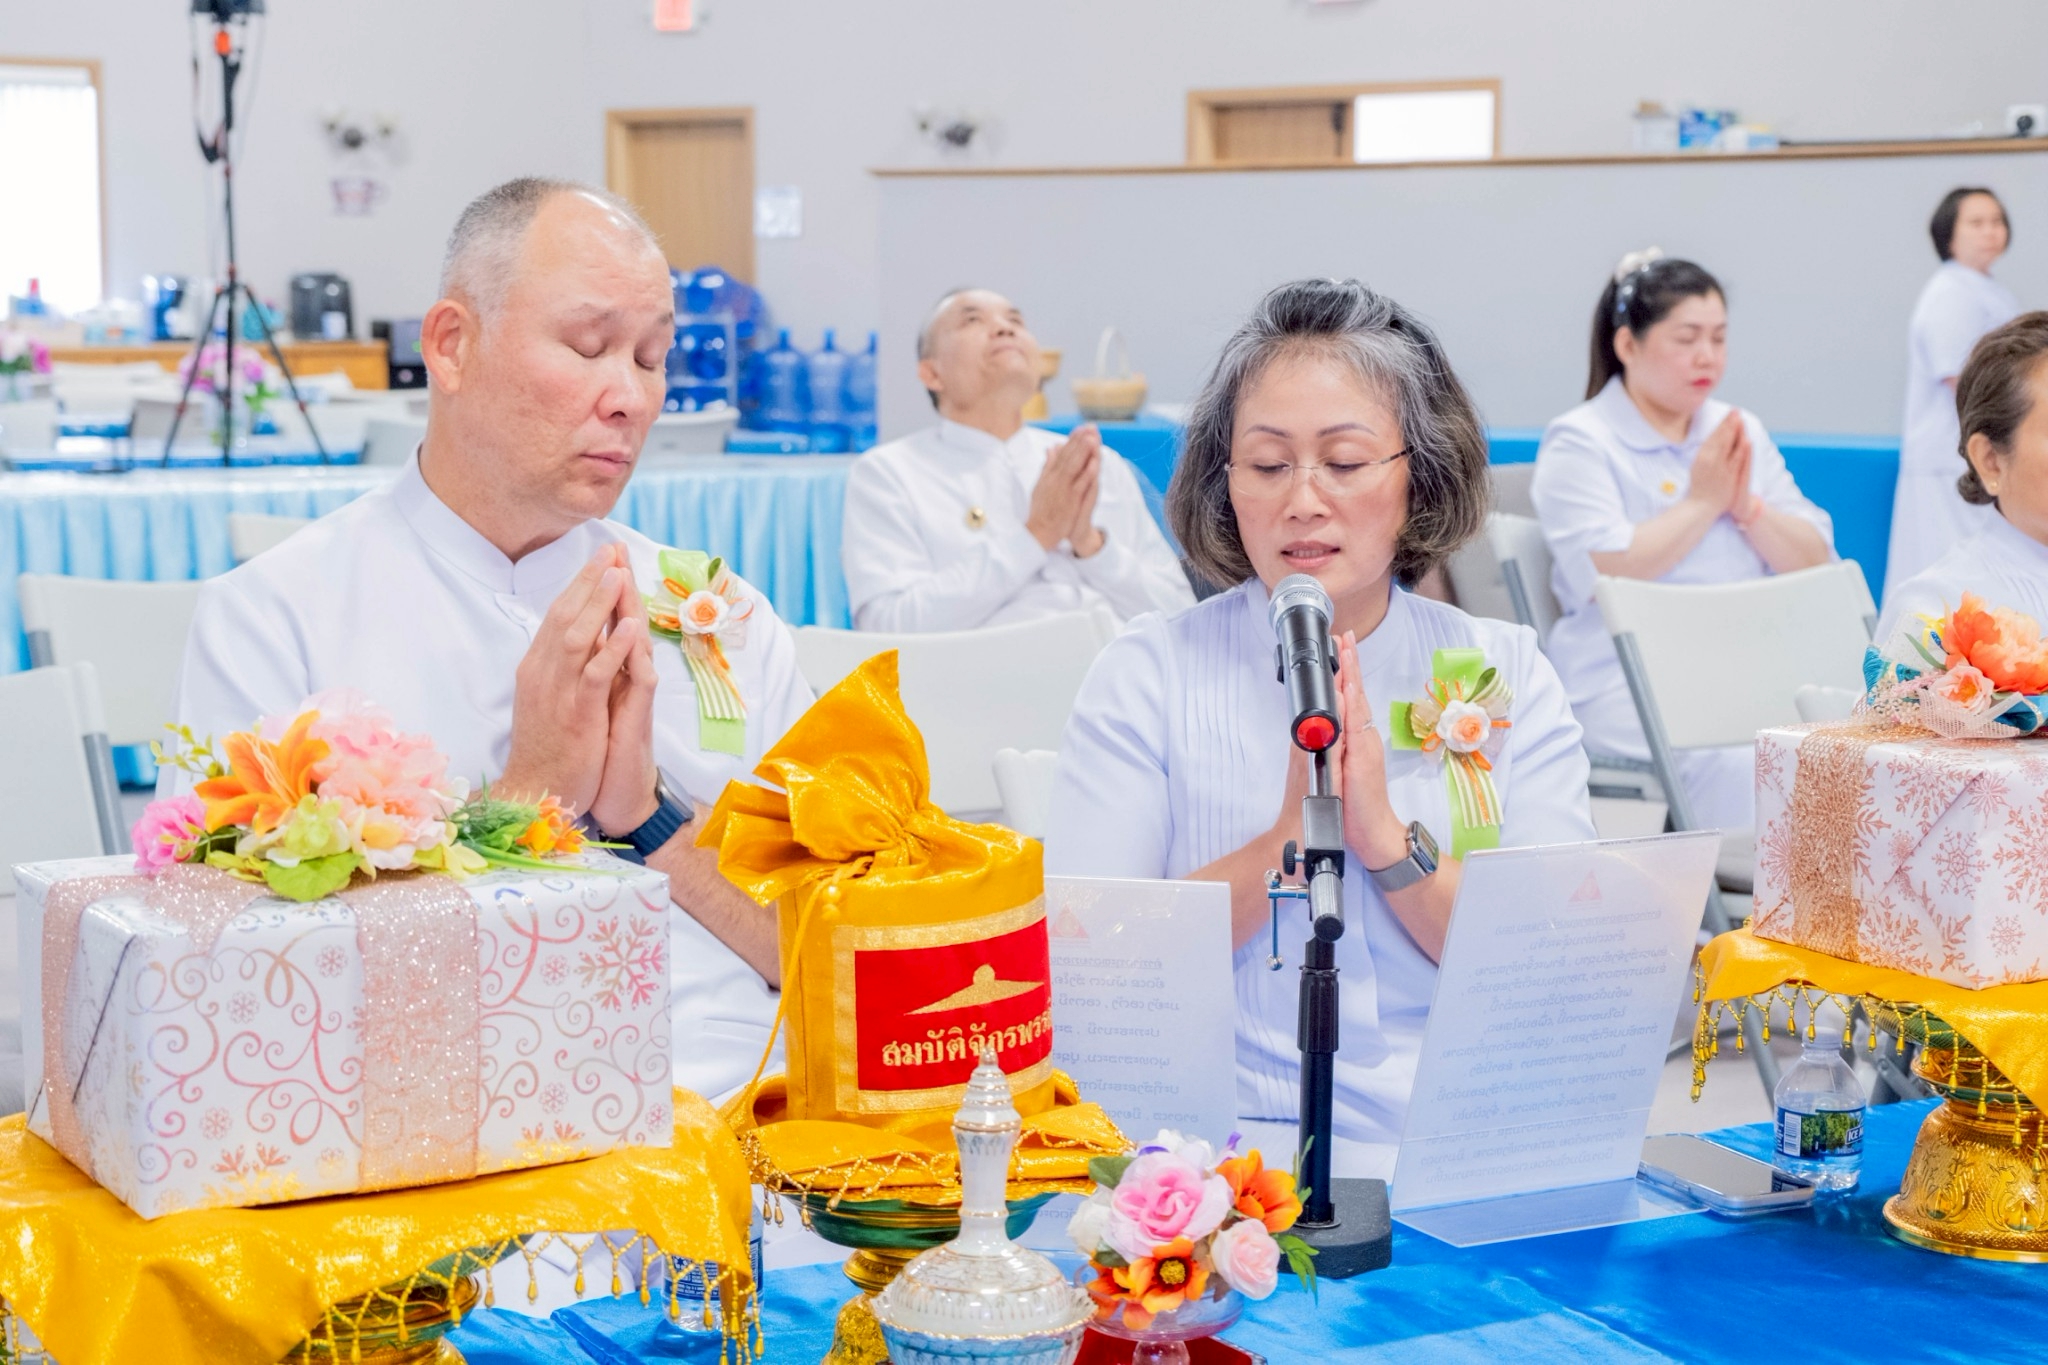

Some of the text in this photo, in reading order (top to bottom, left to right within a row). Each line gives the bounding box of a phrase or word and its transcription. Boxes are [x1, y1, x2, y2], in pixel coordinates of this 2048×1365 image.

[882, 997, 1052, 1067] สมบัติจักรพรร
